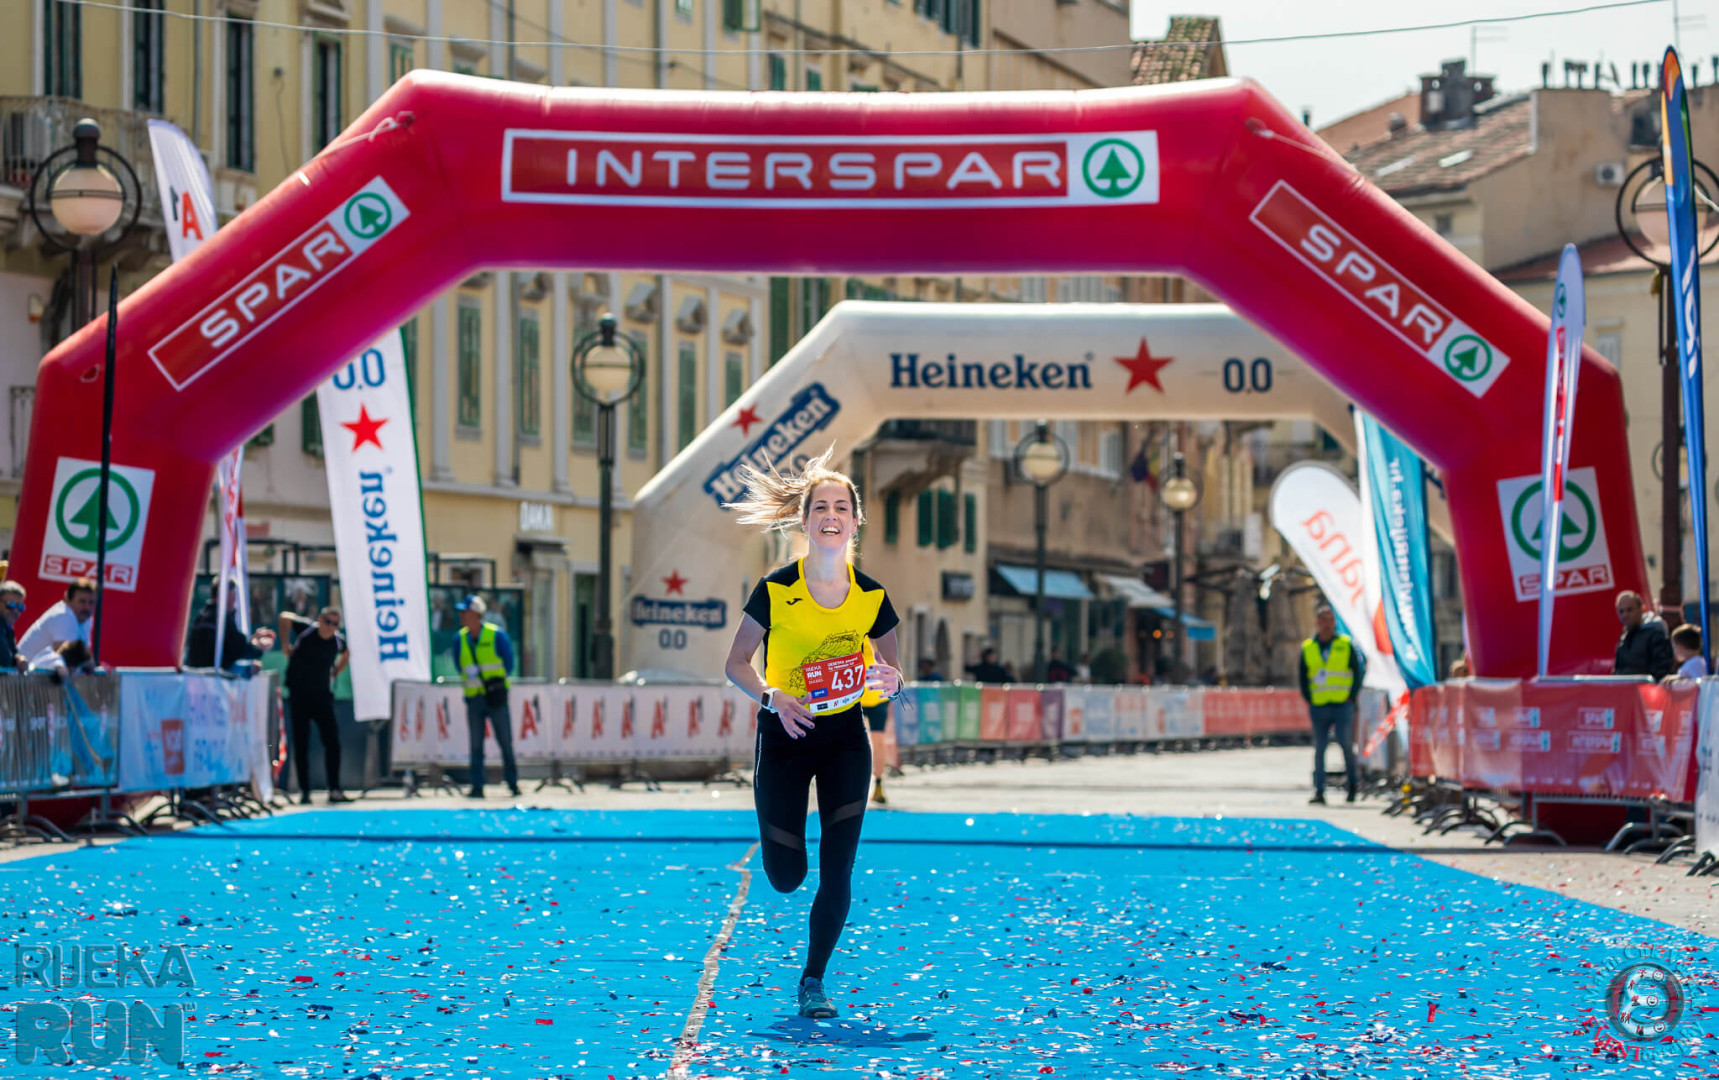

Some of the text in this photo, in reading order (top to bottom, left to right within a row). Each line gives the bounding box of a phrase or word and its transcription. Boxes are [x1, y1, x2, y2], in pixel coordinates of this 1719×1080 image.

[566, 149, 1062, 190] INTERSPAR
[200, 230, 346, 348] SPAR
[1300, 224, 1443, 343] SPAR
[889, 353, 1093, 390] Heineken
[807, 670, 822, 678] RUN
[831, 664, 864, 691] 437
